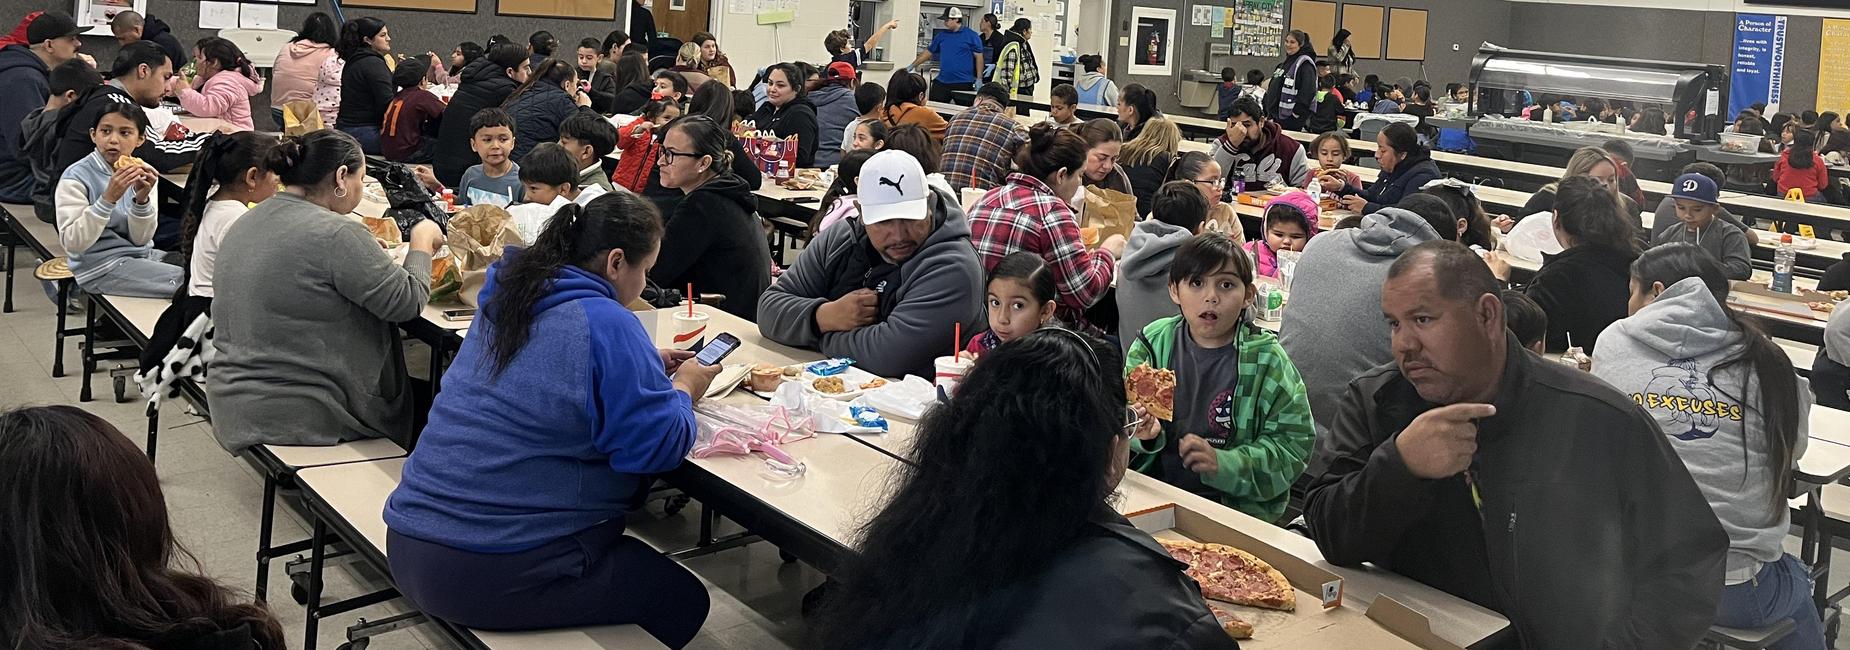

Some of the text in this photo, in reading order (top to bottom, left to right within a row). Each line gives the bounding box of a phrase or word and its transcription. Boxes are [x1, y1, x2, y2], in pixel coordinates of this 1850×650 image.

[1738, 25, 1772, 33] Character
[1771, 18, 1785, 104] TRUSTWORTHINESS
[1682, 179, 1699, 192] D
[1646, 391, 1743, 421] EXCUSES
